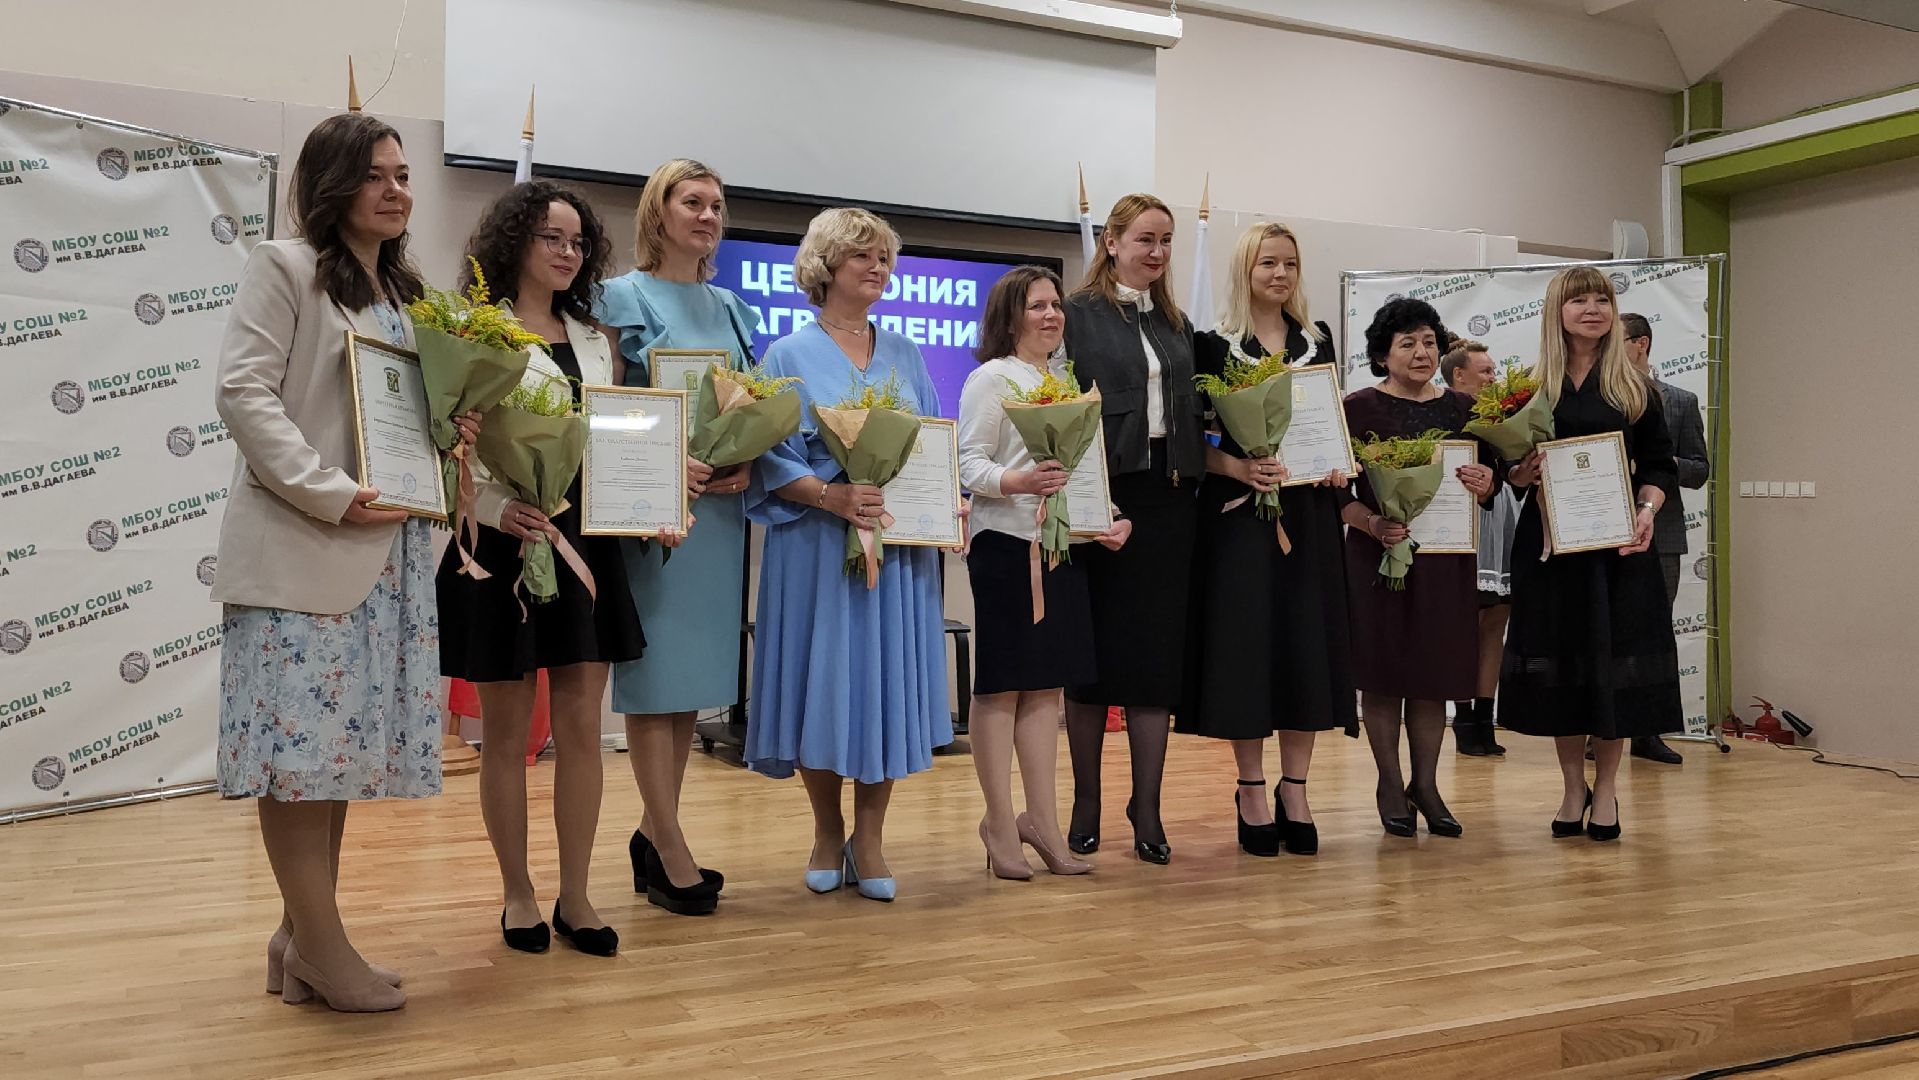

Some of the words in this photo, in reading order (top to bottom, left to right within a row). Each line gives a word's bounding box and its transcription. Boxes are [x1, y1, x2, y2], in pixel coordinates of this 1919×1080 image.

[19, 158, 49, 171] №2
[133, 147, 173, 162] МБОУ
[242, 214, 264, 226] МБ
[52, 235, 97, 251] МБОУ
[102, 229, 139, 244] СОШ
[143, 225, 169, 239] №2
[56, 254, 71, 263] им
[74, 243, 146, 261] В.В.ДАГАЕВА
[741, 260, 977, 307] ЦЕОНИЯ
[1408, 283, 1440, 298] МБОУ
[1444, 274, 1470, 287] СОШ
[168, 288, 207, 304] МБОУ
[171, 307, 185, 315] им
[187, 297, 234, 313] В.В.ДАГА
[14, 315, 53, 331] СОШ
[58, 309, 88, 324] №2
[1493, 304, 1525, 320] МБОУ
[1529, 298, 1545, 309] СО
[1661, 354, 1695, 370] МБОУ
[88, 372, 131, 392] МБОУ
[136, 364, 171, 381] СОШ
[175, 358, 201, 373] №2
[92, 394, 107, 403] им
[109, 378, 178, 399] В.В.ДАГАЕВА
[198, 420, 227, 436] МБО
[201, 438, 214, 446] им
[0, 464, 45, 486] МБОУ
[50, 454, 89, 473] СОШ
[93, 446, 121, 463] №2
[1, 488, 17, 498] им
[21, 467, 96, 493] В.В.ДАГАЕВА
[121, 506, 163, 528] МБОУ
[167, 496, 201, 514] СОШ
[205, 487, 229, 504] №2
[125, 530, 139, 539] им
[142, 508, 208, 533] В.В.ДАГАЕВА
[7, 544, 37, 562] №2
[35, 604, 80, 628] МБОУ
[85, 590, 122, 610] СОШ
[126, 579, 153, 596] №2
[38, 629, 54, 639] им
[57, 602, 129, 633] В.В.ДАГАЕВА
[153, 635, 192, 658] МБОУ
[156, 660, 169, 669] им
[172, 637, 222, 662] В.В.ДАГАЕ
[0, 693, 38, 716] СОШ
[42, 681, 72, 700] №2
[69, 736, 112, 763] МБОУ
[117, 719, 153, 742] СОШ
[157, 707, 184, 725] №2
[72, 764, 88, 774] им
[90, 731, 160, 765] В.В.ДАГАЕВА
